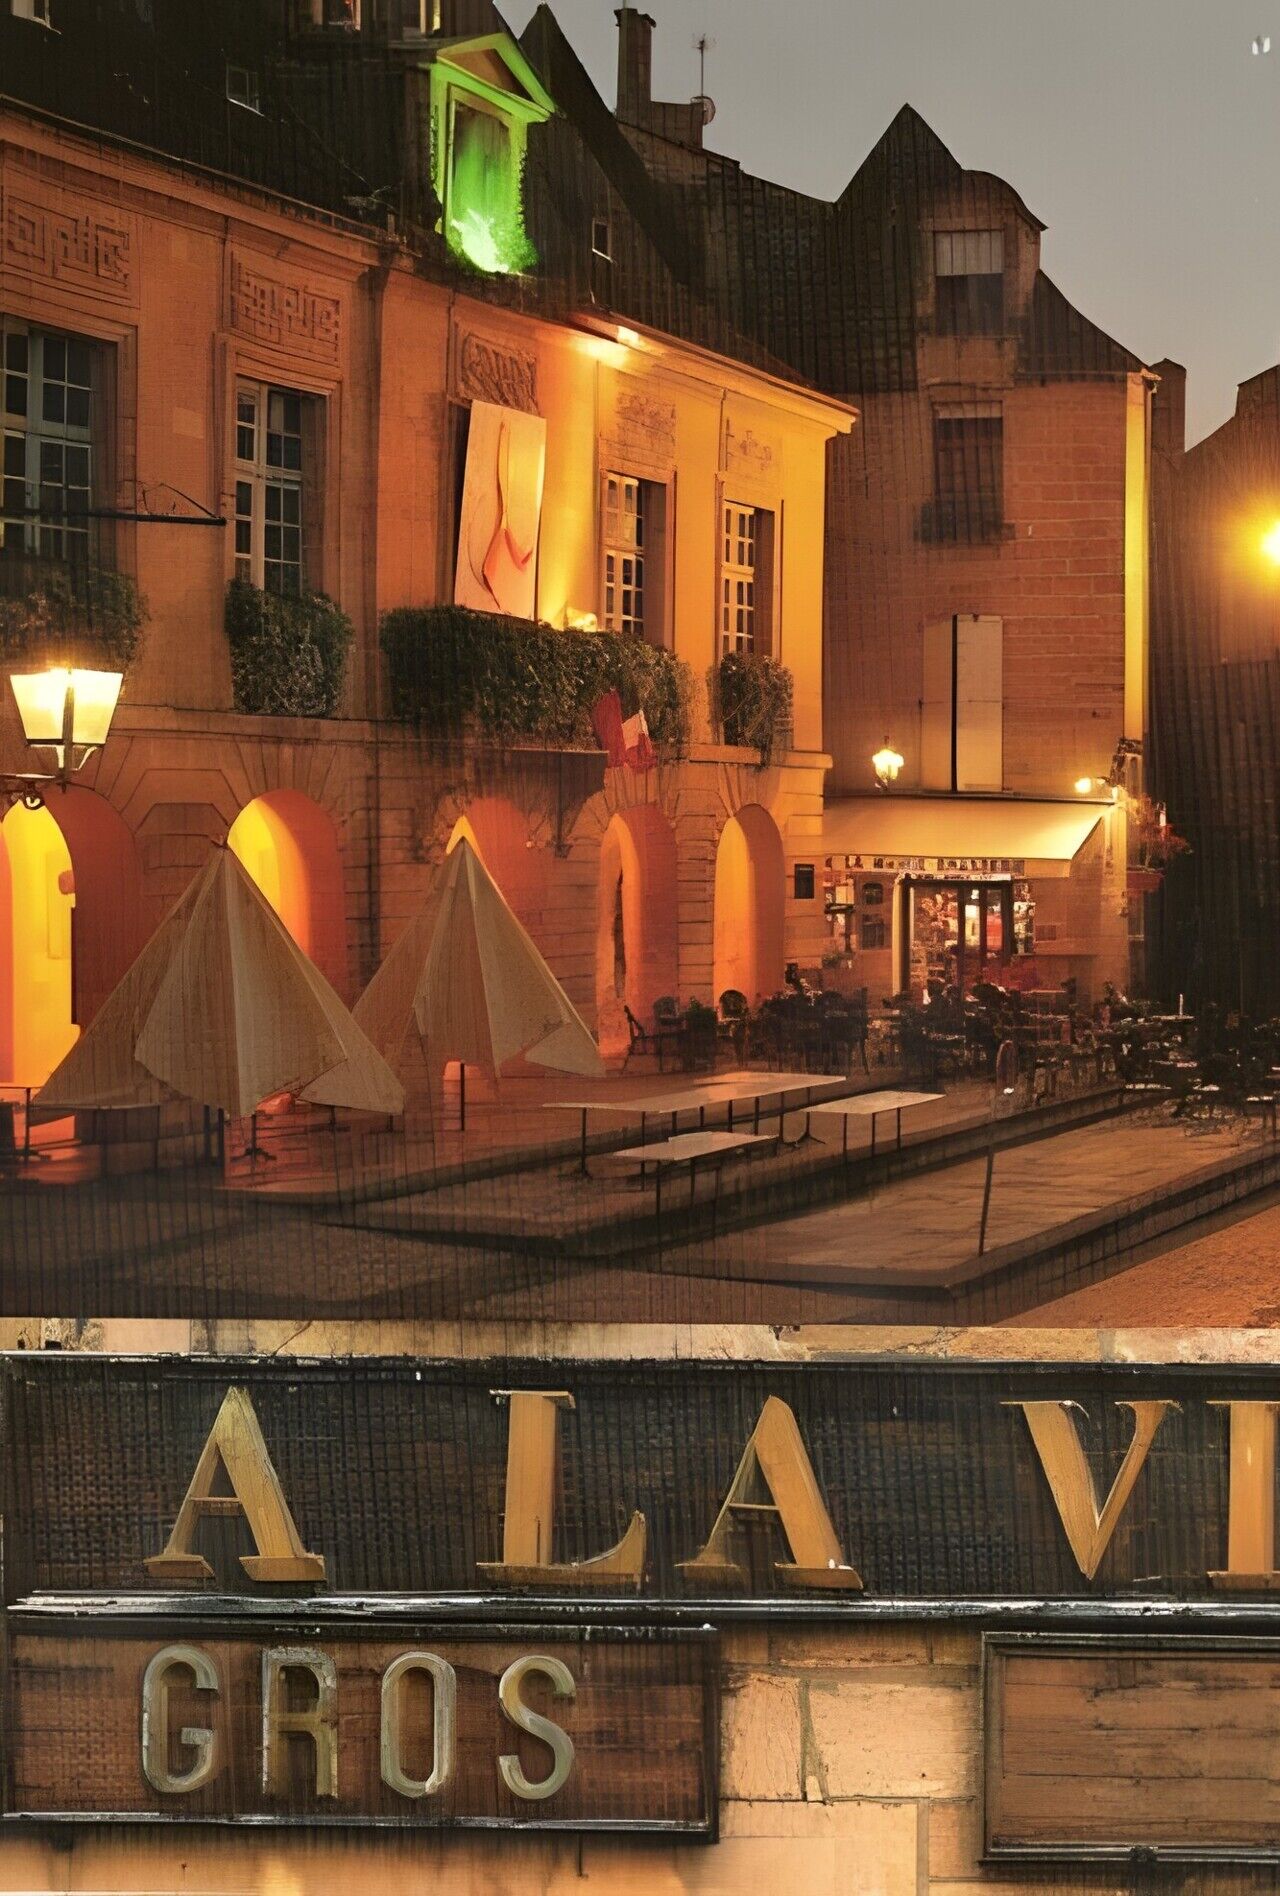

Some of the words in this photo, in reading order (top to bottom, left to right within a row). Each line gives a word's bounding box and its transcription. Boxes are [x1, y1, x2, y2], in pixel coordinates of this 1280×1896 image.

[143, 1386, 325, 1582] A
[476, 1389, 864, 1591] LA
[141, 1643, 578, 1799] GROS
